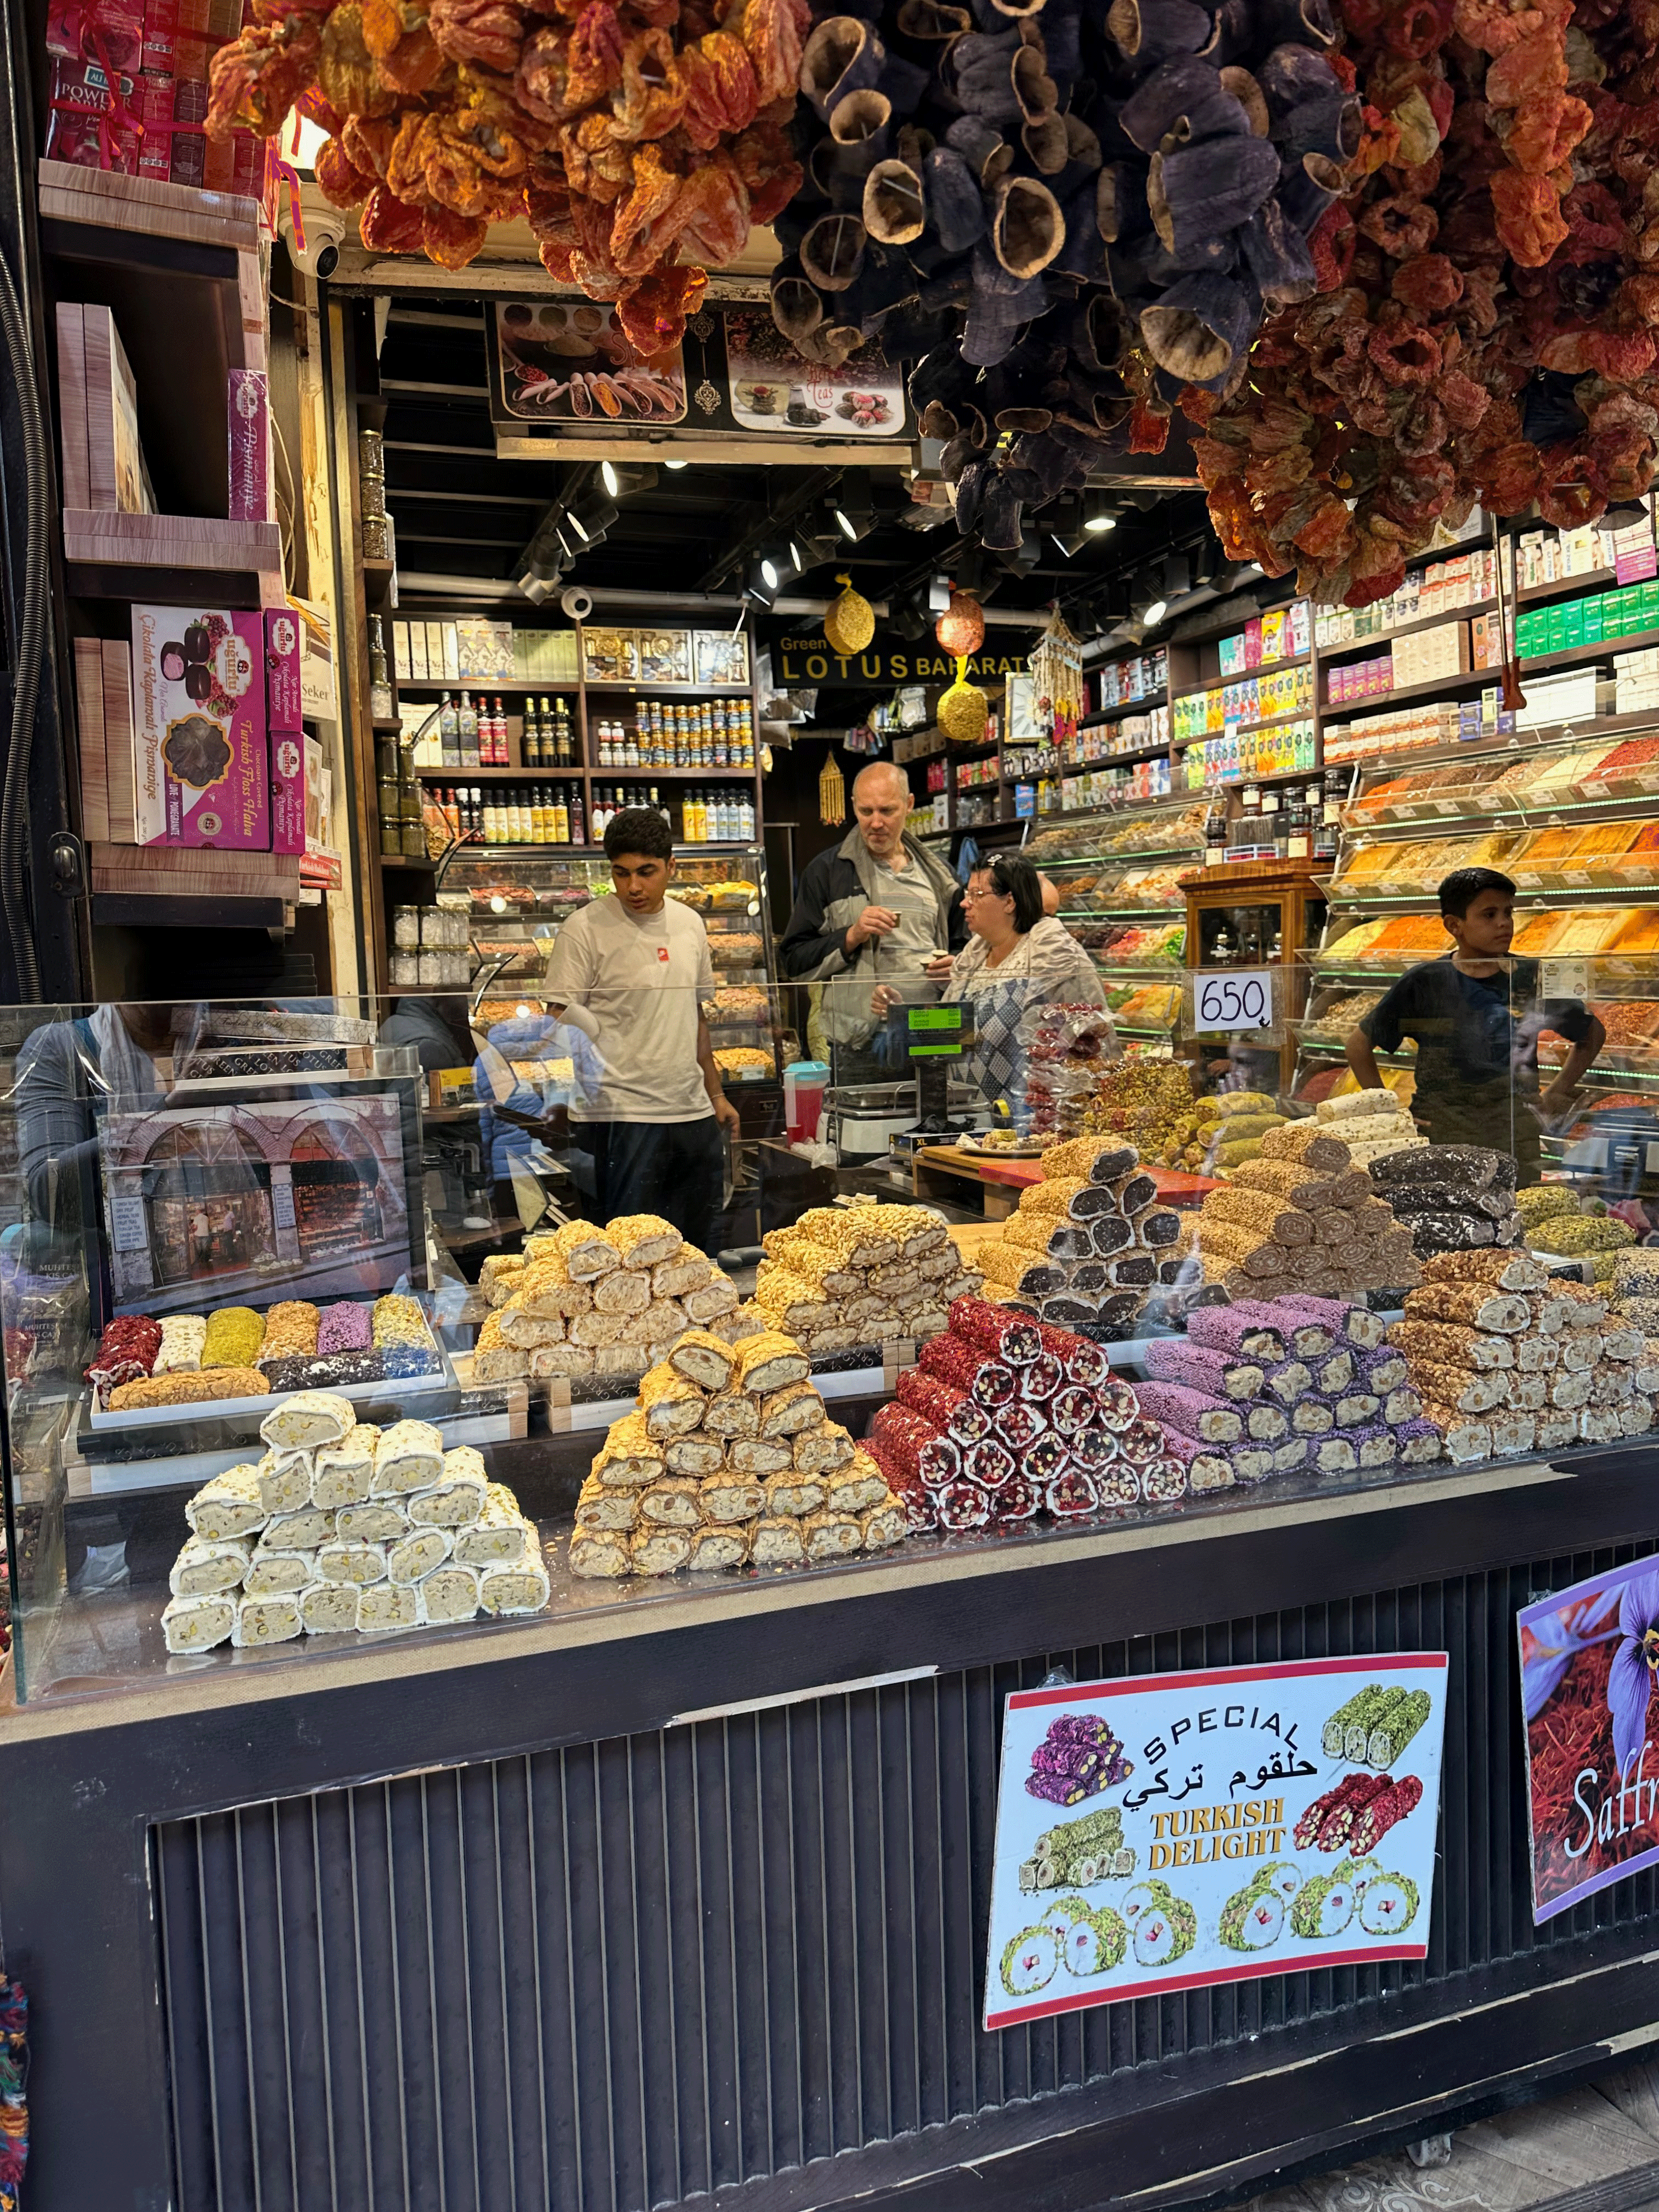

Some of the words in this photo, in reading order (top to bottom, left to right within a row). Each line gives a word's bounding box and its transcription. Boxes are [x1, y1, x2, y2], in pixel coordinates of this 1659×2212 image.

[806, 381, 833, 408] Teas
[139, 614, 155, 666] Çikolata
[780, 637, 827, 650] Green
[224, 639, 240, 692] uğurlu
[782, 654, 909, 679] LOTUS
[142, 667, 156, 730] Kaplamalı
[239, 720, 253, 765] Turkish
[142, 733, 159, 800] Pişmaniye
[238, 766, 256, 796] Floss
[168, 783, 179, 795] LOVE
[170, 801, 180, 836] POMEGRANATE
[242, 799, 258, 837] Halva
[1201, 980, 1265, 1021] 650
[1143, 1705, 1299, 1765] SPECIAL
[1122, 1764, 1204, 1813] تركي
[1229, 1752, 1318, 1799] حلقوم
[1149, 1797, 1285, 1841] TURKISH
[1148, 1827, 1287, 1871] DELIGHT
